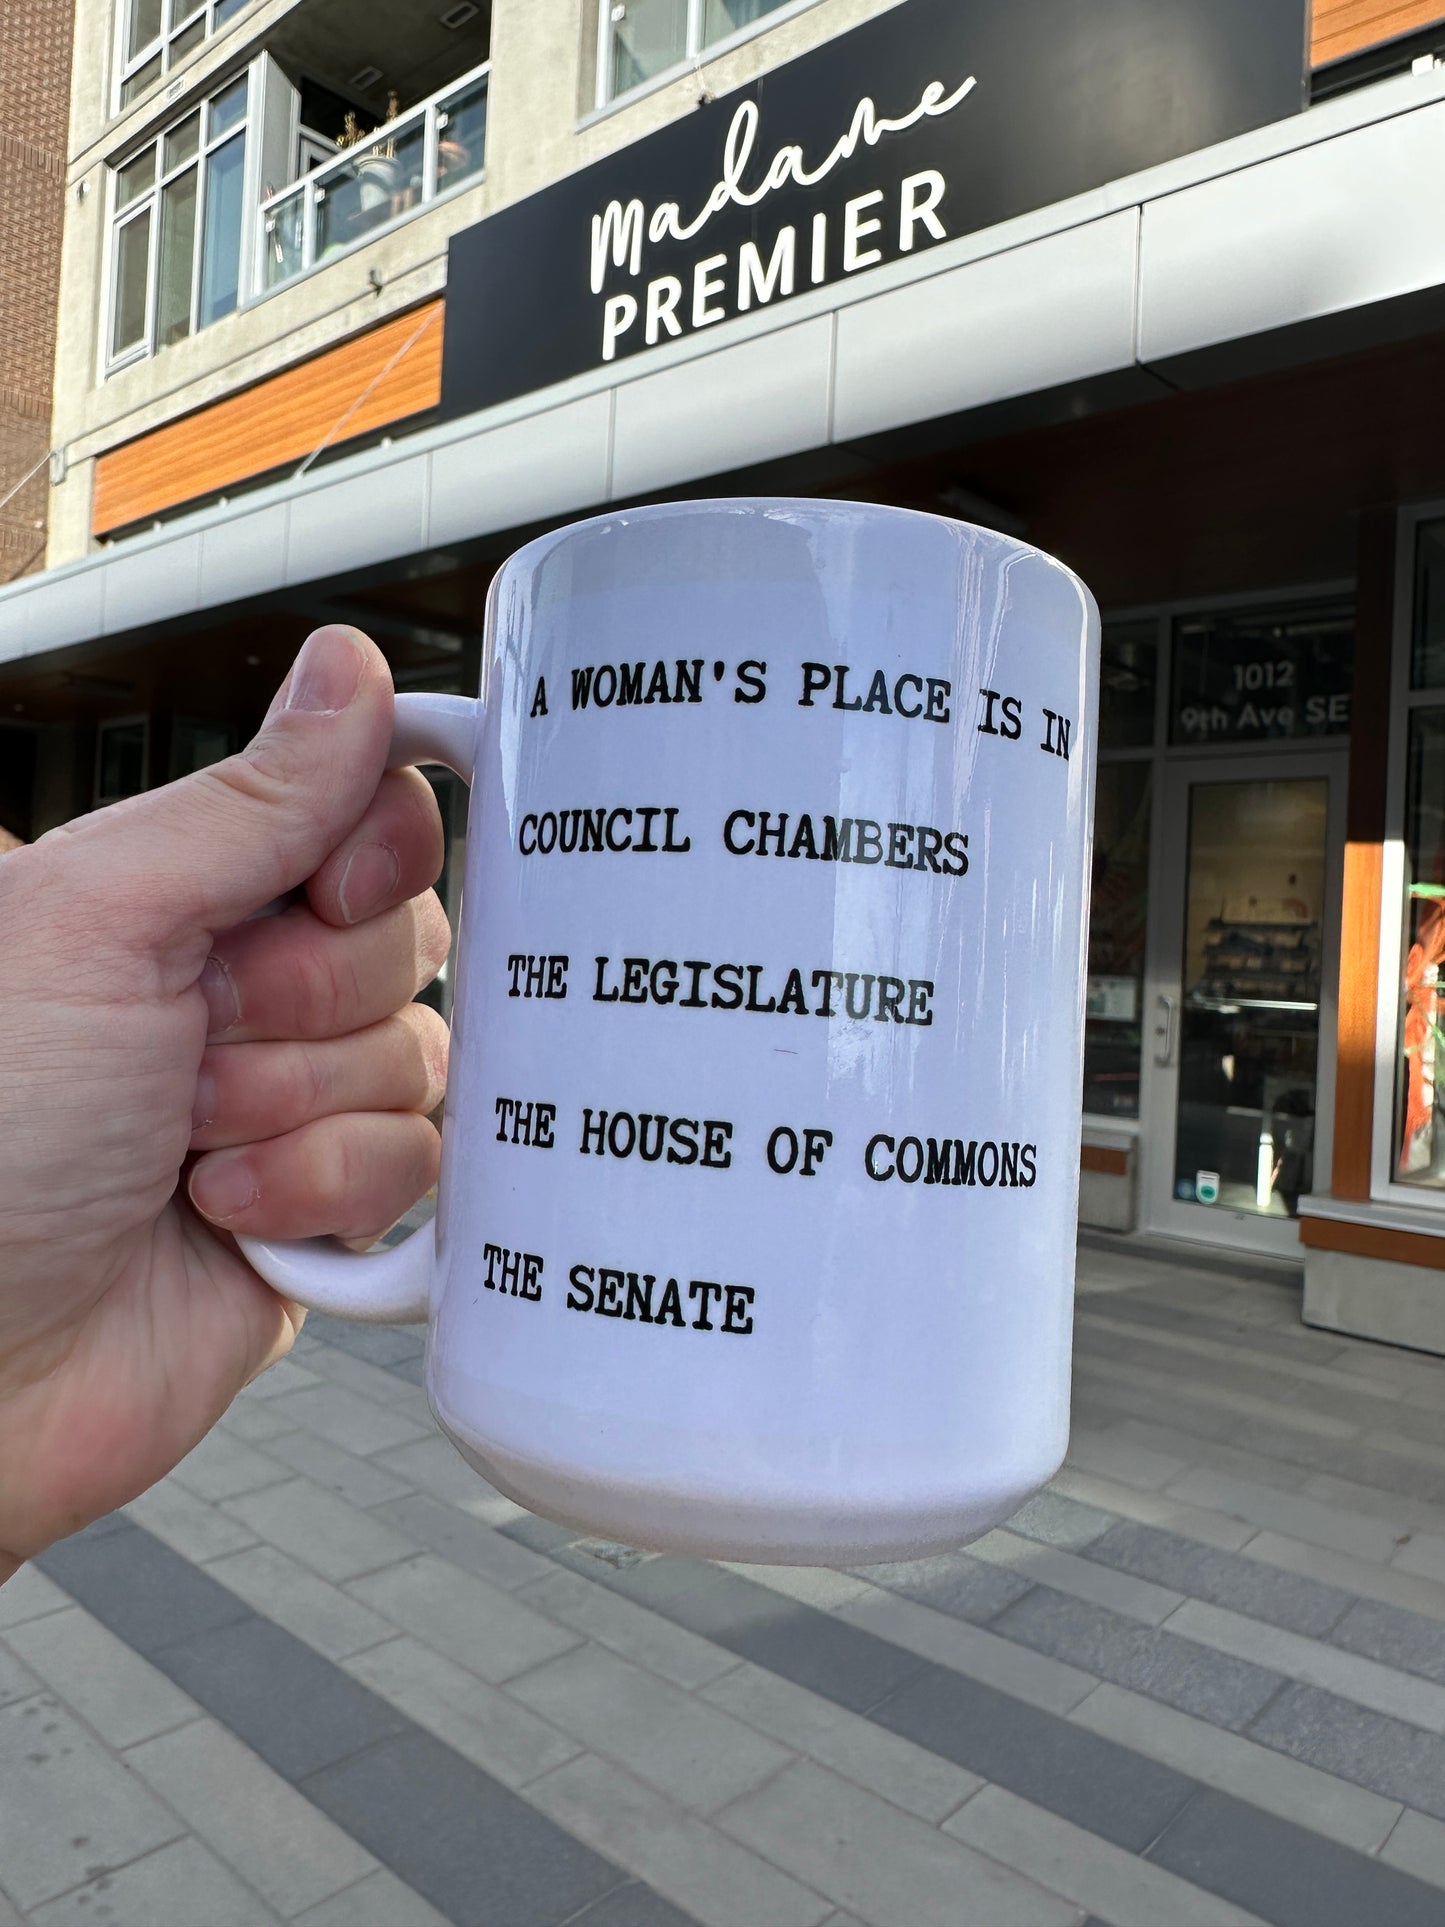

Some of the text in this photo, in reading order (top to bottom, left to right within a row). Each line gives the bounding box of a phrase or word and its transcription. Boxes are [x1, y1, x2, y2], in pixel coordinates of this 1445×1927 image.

[589, 75, 978, 295] Madame
[602, 169, 947, 361] PREMIER
[529, 658, 1071, 762] A WOMAN'S PLACE IS IN
[1180, 694, 1351, 733] 9th Ave SE
[1233, 661, 1296, 691] 1012
[518, 807, 969, 877] COUNCIL CHAMBERS
[507, 954, 935, 1027] THE LEGISLATURE
[494, 1096, 1037, 1188] THE HOUSE OF COMMONS
[482, 1242, 756, 1335] THE SENATE
